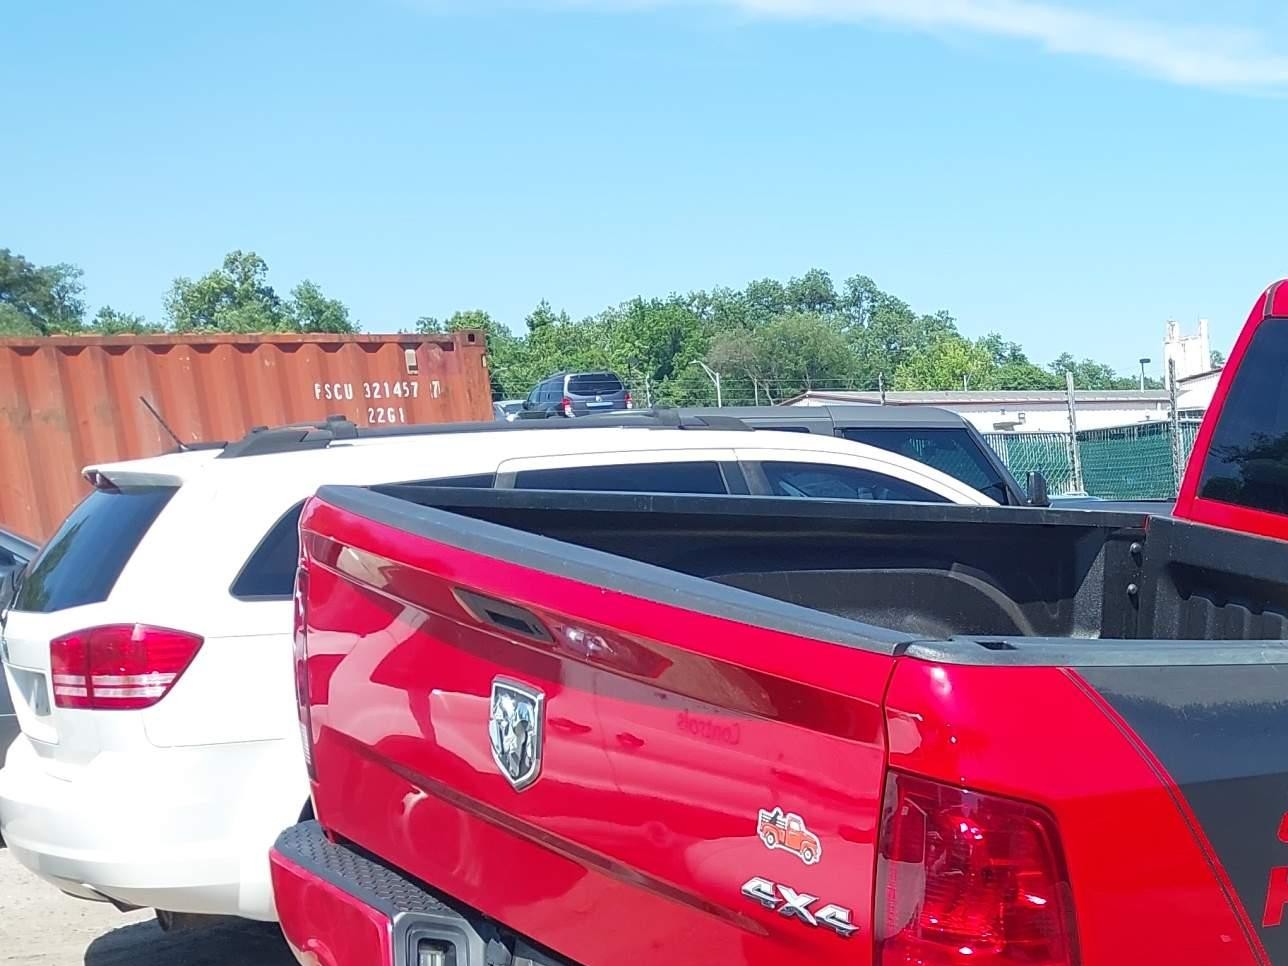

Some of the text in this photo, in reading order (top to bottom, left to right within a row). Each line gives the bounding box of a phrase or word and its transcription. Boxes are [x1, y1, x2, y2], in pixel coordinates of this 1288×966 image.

[314, 383, 353, 400] FSCU
[363, 381, 418, 398] 321457
[368, 407, 404, 423] 22G1
